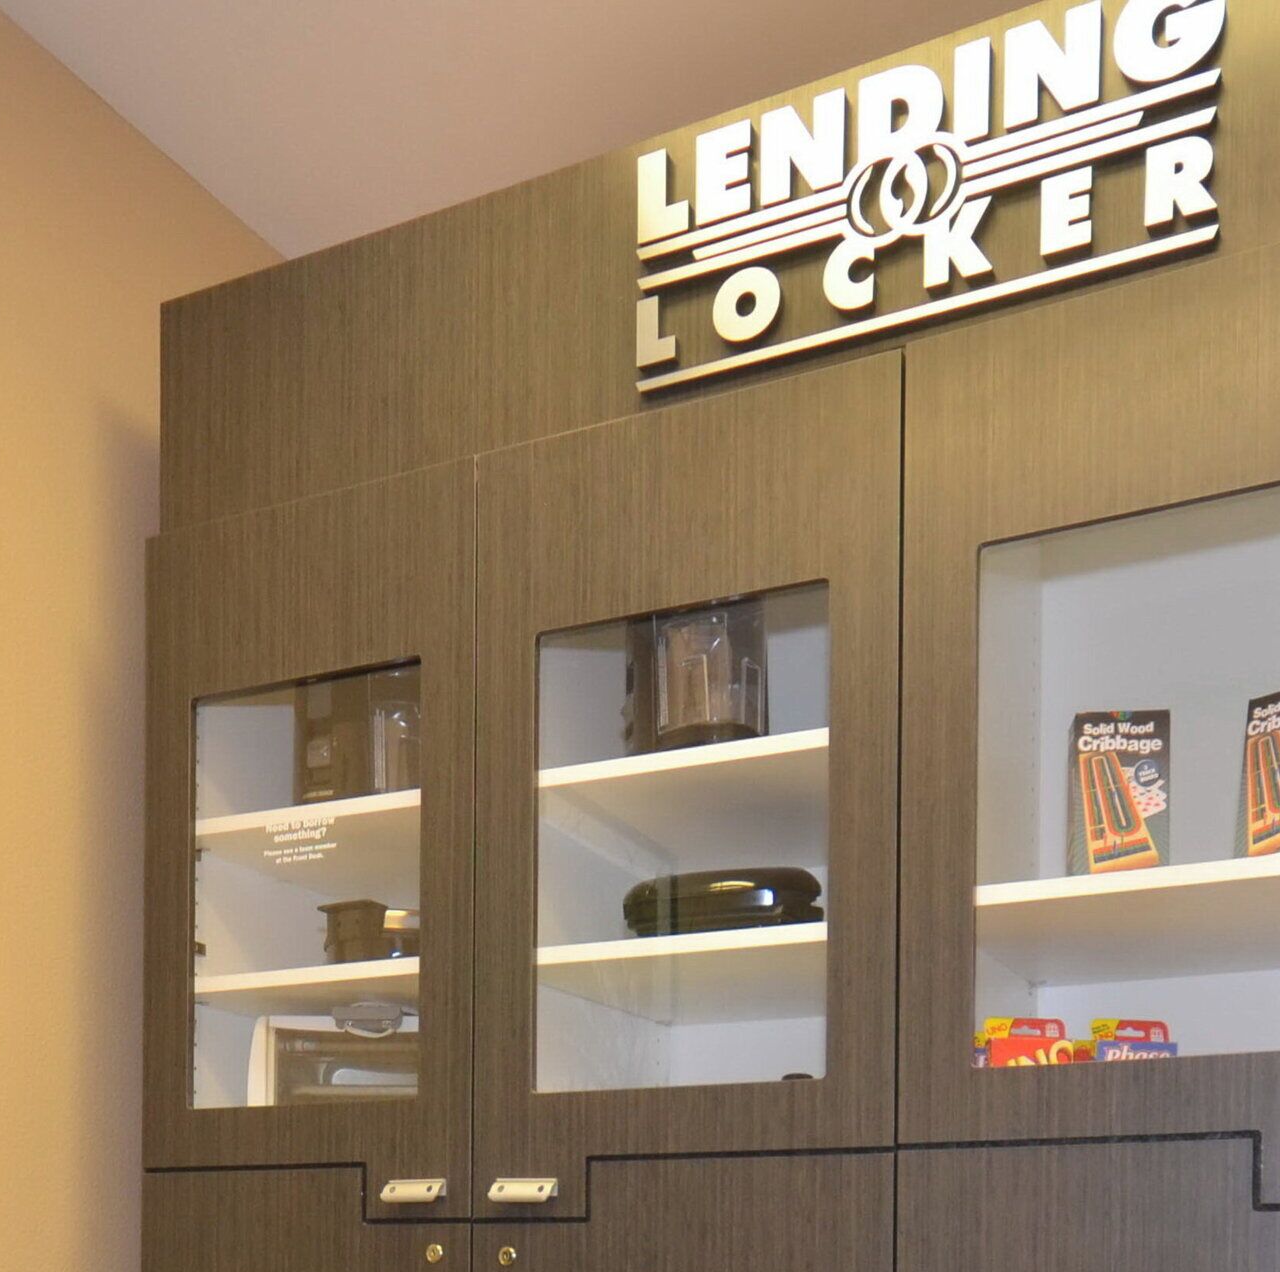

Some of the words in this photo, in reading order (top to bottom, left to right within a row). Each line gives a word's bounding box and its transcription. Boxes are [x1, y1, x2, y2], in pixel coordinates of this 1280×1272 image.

[637, 0, 1225, 245] LENDING
[636, 137, 1218, 368] LOCKER
[1083, 722, 1115, 736] Solid
[1117, 721, 1154, 734] Wood
[1078, 735, 1163, 754] Cribbage
[291, 818, 301, 829] to
[303, 815, 335, 828] borrow
[274, 826, 327, 842] something?
[987, 1023, 1008, 1035] UNO
